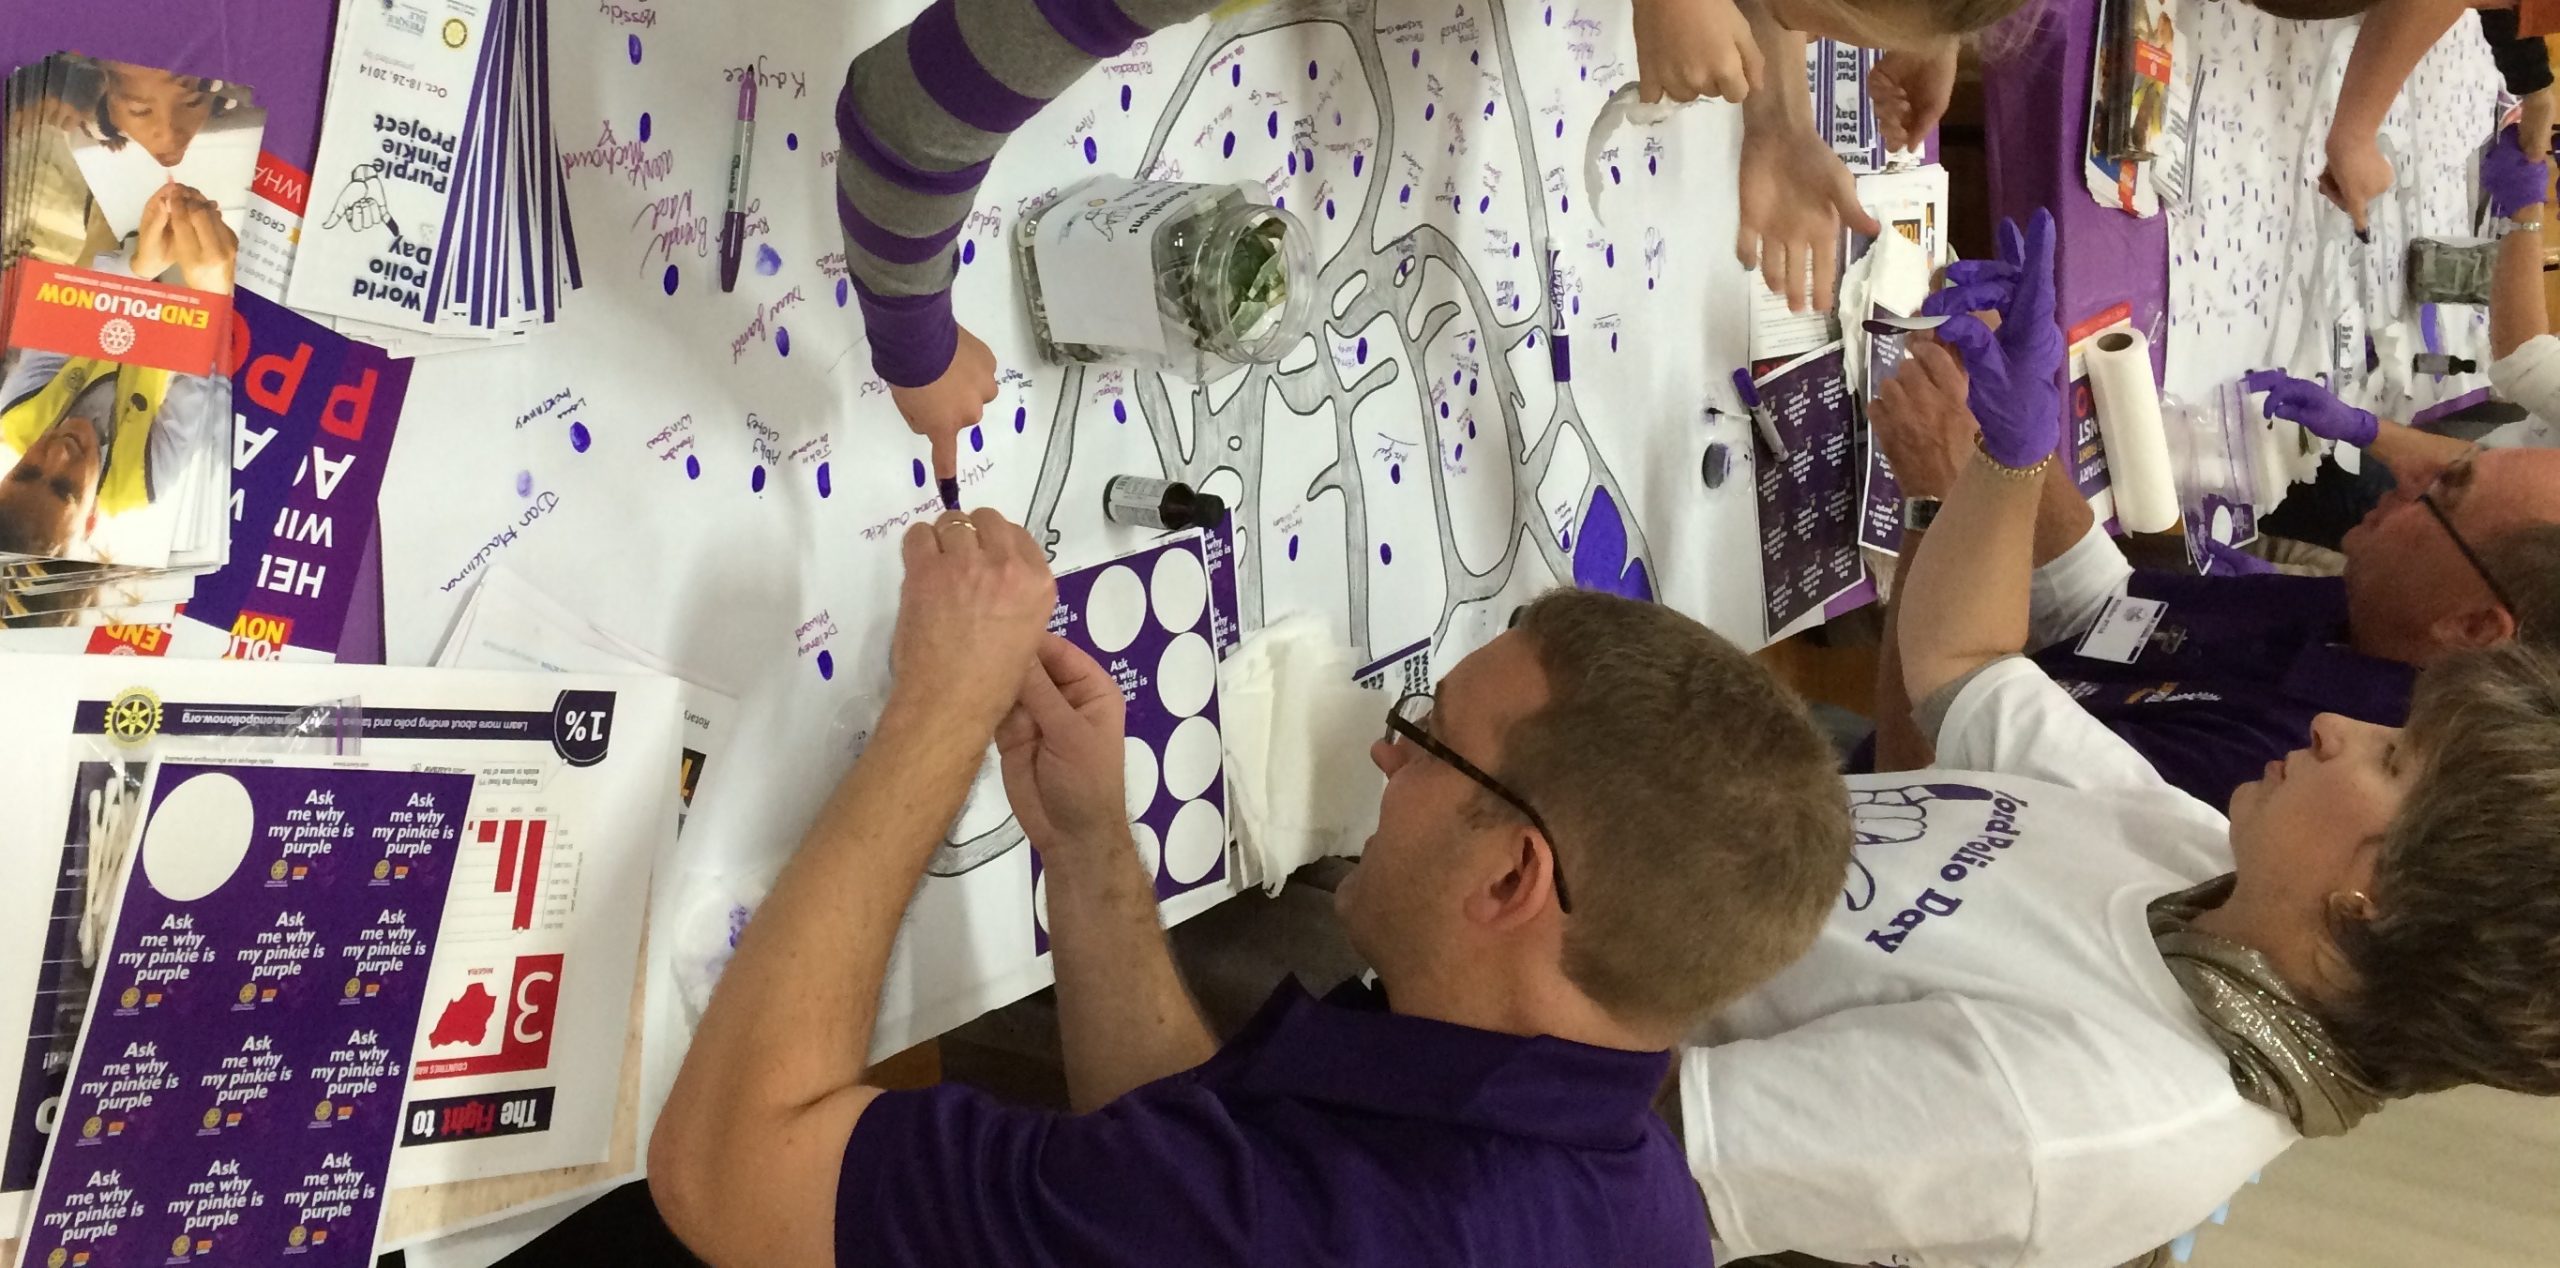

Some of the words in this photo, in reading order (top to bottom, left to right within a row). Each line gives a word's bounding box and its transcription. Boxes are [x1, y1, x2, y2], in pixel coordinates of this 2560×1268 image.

[359, 63, 390, 80] 2014
[723, 56, 806, 99] Kayee
[373, 114, 456, 153] Project
[382, 139, 452, 173] Pinkie
[373, 158, 448, 194] Purple
[250, 209, 286, 233] CROSS
[388, 235, 432, 265] Day
[369, 259, 428, 289] Polio
[353, 279, 421, 312] World
[1110, 658, 1128, 672] Ask
[1119, 668, 1138, 681] why
[373, 718, 392, 729] and
[393, 716, 418, 729] polio
[418, 716, 450, 731] ending
[451, 719, 478, 731] about
[479, 720, 502, 729] more
[504, 720, 528, 732] Learn
[565, 708, 608, 743] 1%
[305, 790, 334, 804] Ask
[407, 793, 434, 807] Ask
[287, 810, 311, 821] me
[316, 807, 344, 825] why
[390, 812, 412, 822] me
[417, 809, 444, 828] why
[268, 826, 292, 841] my
[294, 823, 339, 841] pinkie
[343, 823, 354, 837] is
[372, 828, 398, 842] my
[396, 824, 439, 842] pinkie
[443, 825, 454, 839] is
[282, 839, 331, 858] purple
[386, 840, 432, 858] purple
[1940, 835, 2014, 882] Polio
[162, 914, 194, 929] Ask
[276, 912, 305, 926] Ask
[378, 910, 406, 924] Ask
[1865, 888, 1963, 954] Day
[140, 936, 168, 946] me
[174, 931, 205, 950] why
[257, 933, 281, 943] me
[286, 928, 315, 948] why
[360, 930, 384, 940] me
[388, 925, 416, 944] why
[118, 953, 146, 968] my
[148, 948, 199, 968] pinkie
[203, 947, 215, 962] is
[238, 950, 262, 964] my
[264, 944, 309, 964] pinkie
[313, 944, 324, 958] is
[343, 946, 365, 960] my
[367, 941, 411, 960] pinkie
[415, 941, 426, 955] is
[135, 964, 189, 985] purple
[252, 961, 301, 981] purple
[356, 957, 403, 976] purple
[513, 969, 554, 1044] 3
[242, 1036, 272, 1051] Ask
[348, 1030, 377, 1044] Ask
[124, 1042, 156, 1057] Ask
[330, 1050, 354, 1061] me
[359, 1046, 388, 1064] why
[103, 1064, 130, 1076] me
[136, 1058, 169, 1078] why
[222, 1057, 248, 1068] me
[253, 1052, 282, 1069] why
[202, 1074, 231, 1089] my
[229, 1068, 276, 1088] pinkie
[280, 1066, 292, 1080] is
[311, 1068, 335, 1082] my
[338, 1062, 388, 1082] pinkie
[388, 1062, 400, 1076] is
[81, 1082, 111, 1098] my
[110, 1075, 162, 1096] pinkie
[166, 1074, 178, 1088] is
[216, 1084, 268, 1106] purple
[326, 1078, 376, 1098] purple
[97, 1092, 152, 1114] purple
[442, 1100, 497, 1136] Fight
[500, 1098, 537, 1128] The
[412, 1110, 435, 1137] to
[208, 1160, 240, 1176] Ask
[322, 1153, 352, 1168] Ask
[87, 1170, 120, 1187] Ask
[188, 1182, 214, 1194] me
[220, 1176, 252, 1195] why
[304, 1174, 329, 1186] me
[334, 1169, 364, 1187] why
[66, 1193, 94, 1206] me
[100, 1186, 132, 1207] why
[168, 1200, 194, 1216] my
[197, 1196, 250, 1215] pinkie
[251, 1191, 264, 1206] is
[284, 1192, 309, 1207] my
[312, 1185, 359, 1206] pinkie
[363, 1184, 374, 1198] is
[44, 1209, 72, 1228] my
[74, 1204, 126, 1227] pinkie
[131, 1201, 144, 1216] is
[184, 1210, 238, 1233] purple
[301, 1202, 351, 1224] purple
[60, 1223, 117, 1245] purple
